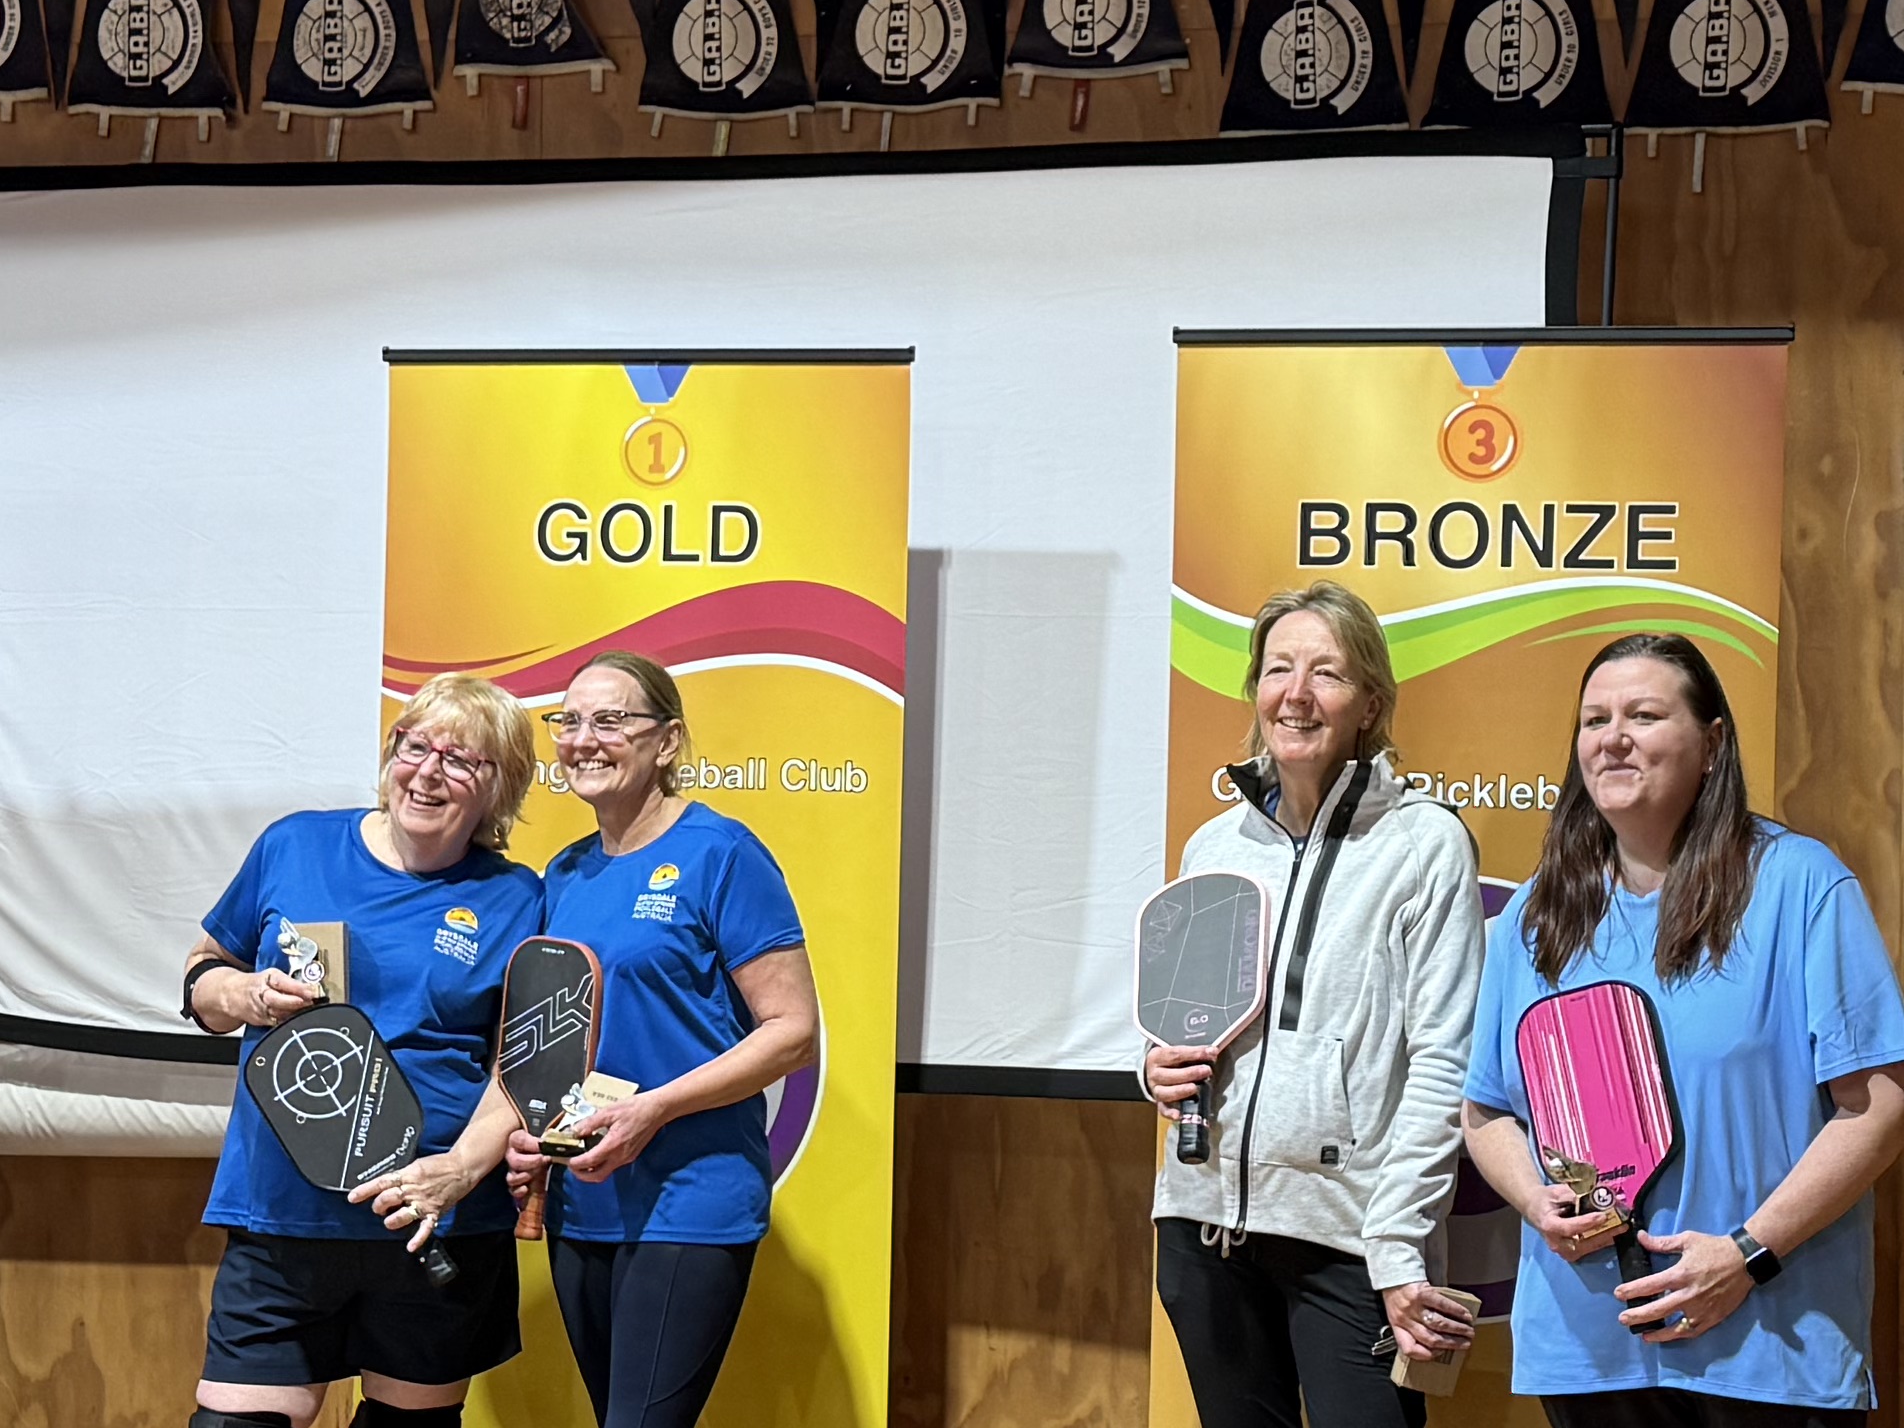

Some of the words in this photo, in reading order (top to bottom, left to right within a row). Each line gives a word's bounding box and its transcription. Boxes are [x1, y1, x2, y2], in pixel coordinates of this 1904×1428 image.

[1294, 5, 1315, 101] G.A.B.A
[645, 431, 667, 474] 1
[1467, 419, 1497, 466] 3
[535, 500, 760, 565] GOLD
[1298, 500, 1678, 570] BRONZE
[678, 757, 767, 791] eball
[780, 758, 870, 794] Club
[1406, 771, 1561, 811] Pickleb
[354, 1093, 376, 1157] PURSUIT
